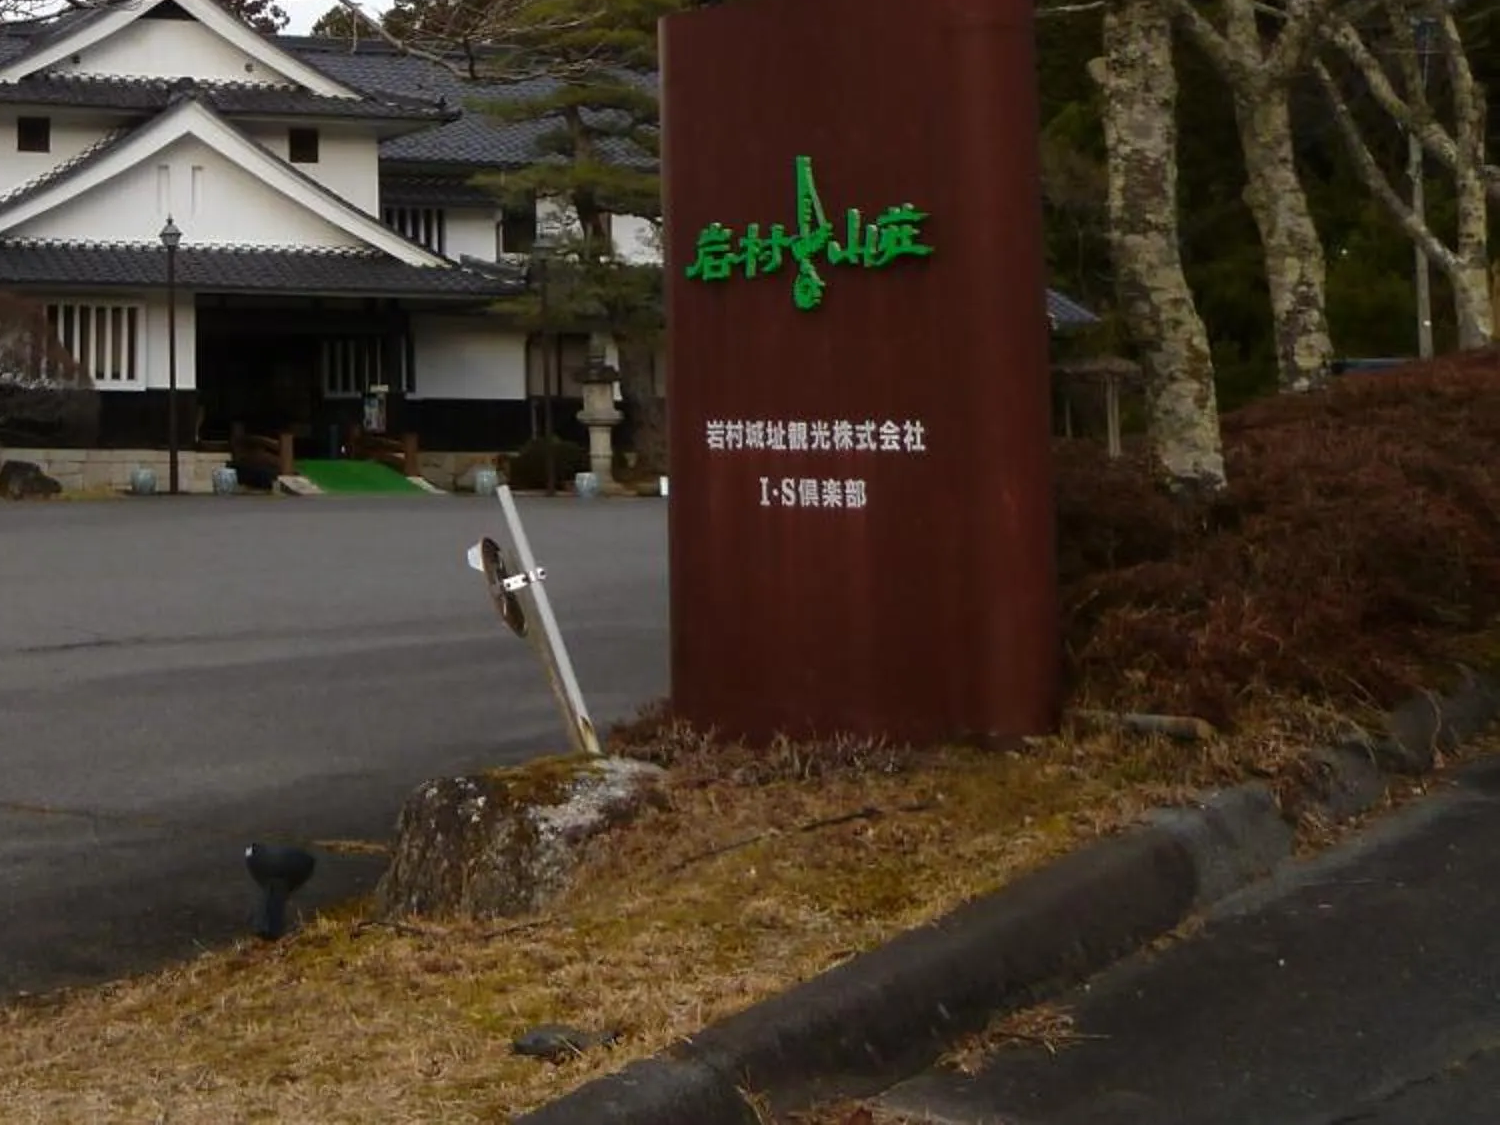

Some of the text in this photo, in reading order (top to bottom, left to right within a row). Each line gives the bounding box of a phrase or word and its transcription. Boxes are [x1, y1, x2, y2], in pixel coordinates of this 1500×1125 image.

[706, 419, 927, 452] 岩村城址観光株式会社
